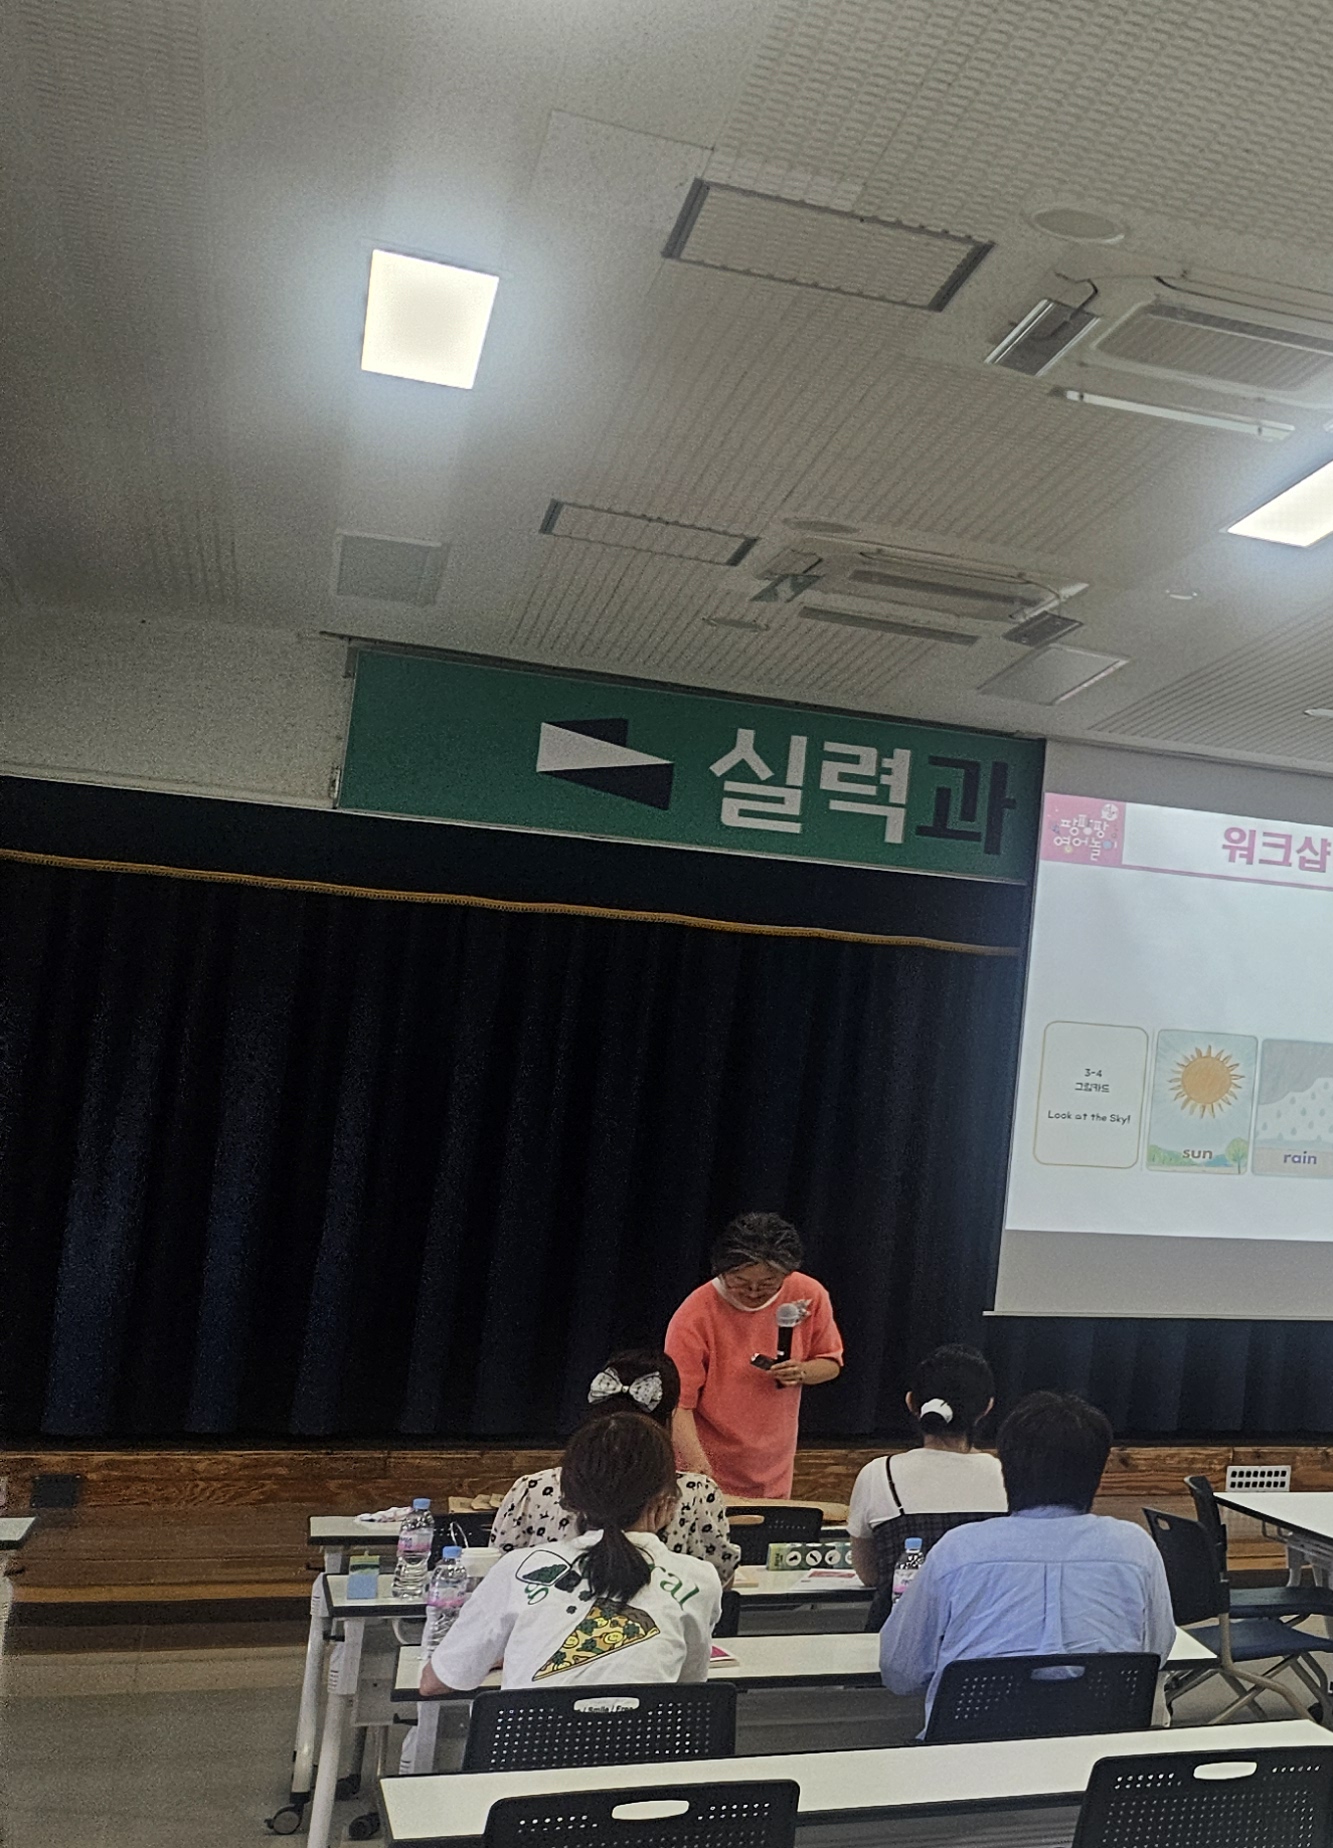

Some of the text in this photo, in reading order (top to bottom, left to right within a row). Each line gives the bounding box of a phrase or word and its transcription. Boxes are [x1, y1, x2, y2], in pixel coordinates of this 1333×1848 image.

[708, 727, 1018, 857] 실력과
[1222, 826, 1332, 873] 워크샵
[1084, 1067, 1103, 1078] 3-4
[1047, 1109, 1073, 1120] Look
[1075, 1112, 1088, 1121] at
[1091, 1112, 1107, 1122] the
[1182, 1148, 1213, 1160] sun
[1283, 1151, 1318, 1165] rain
